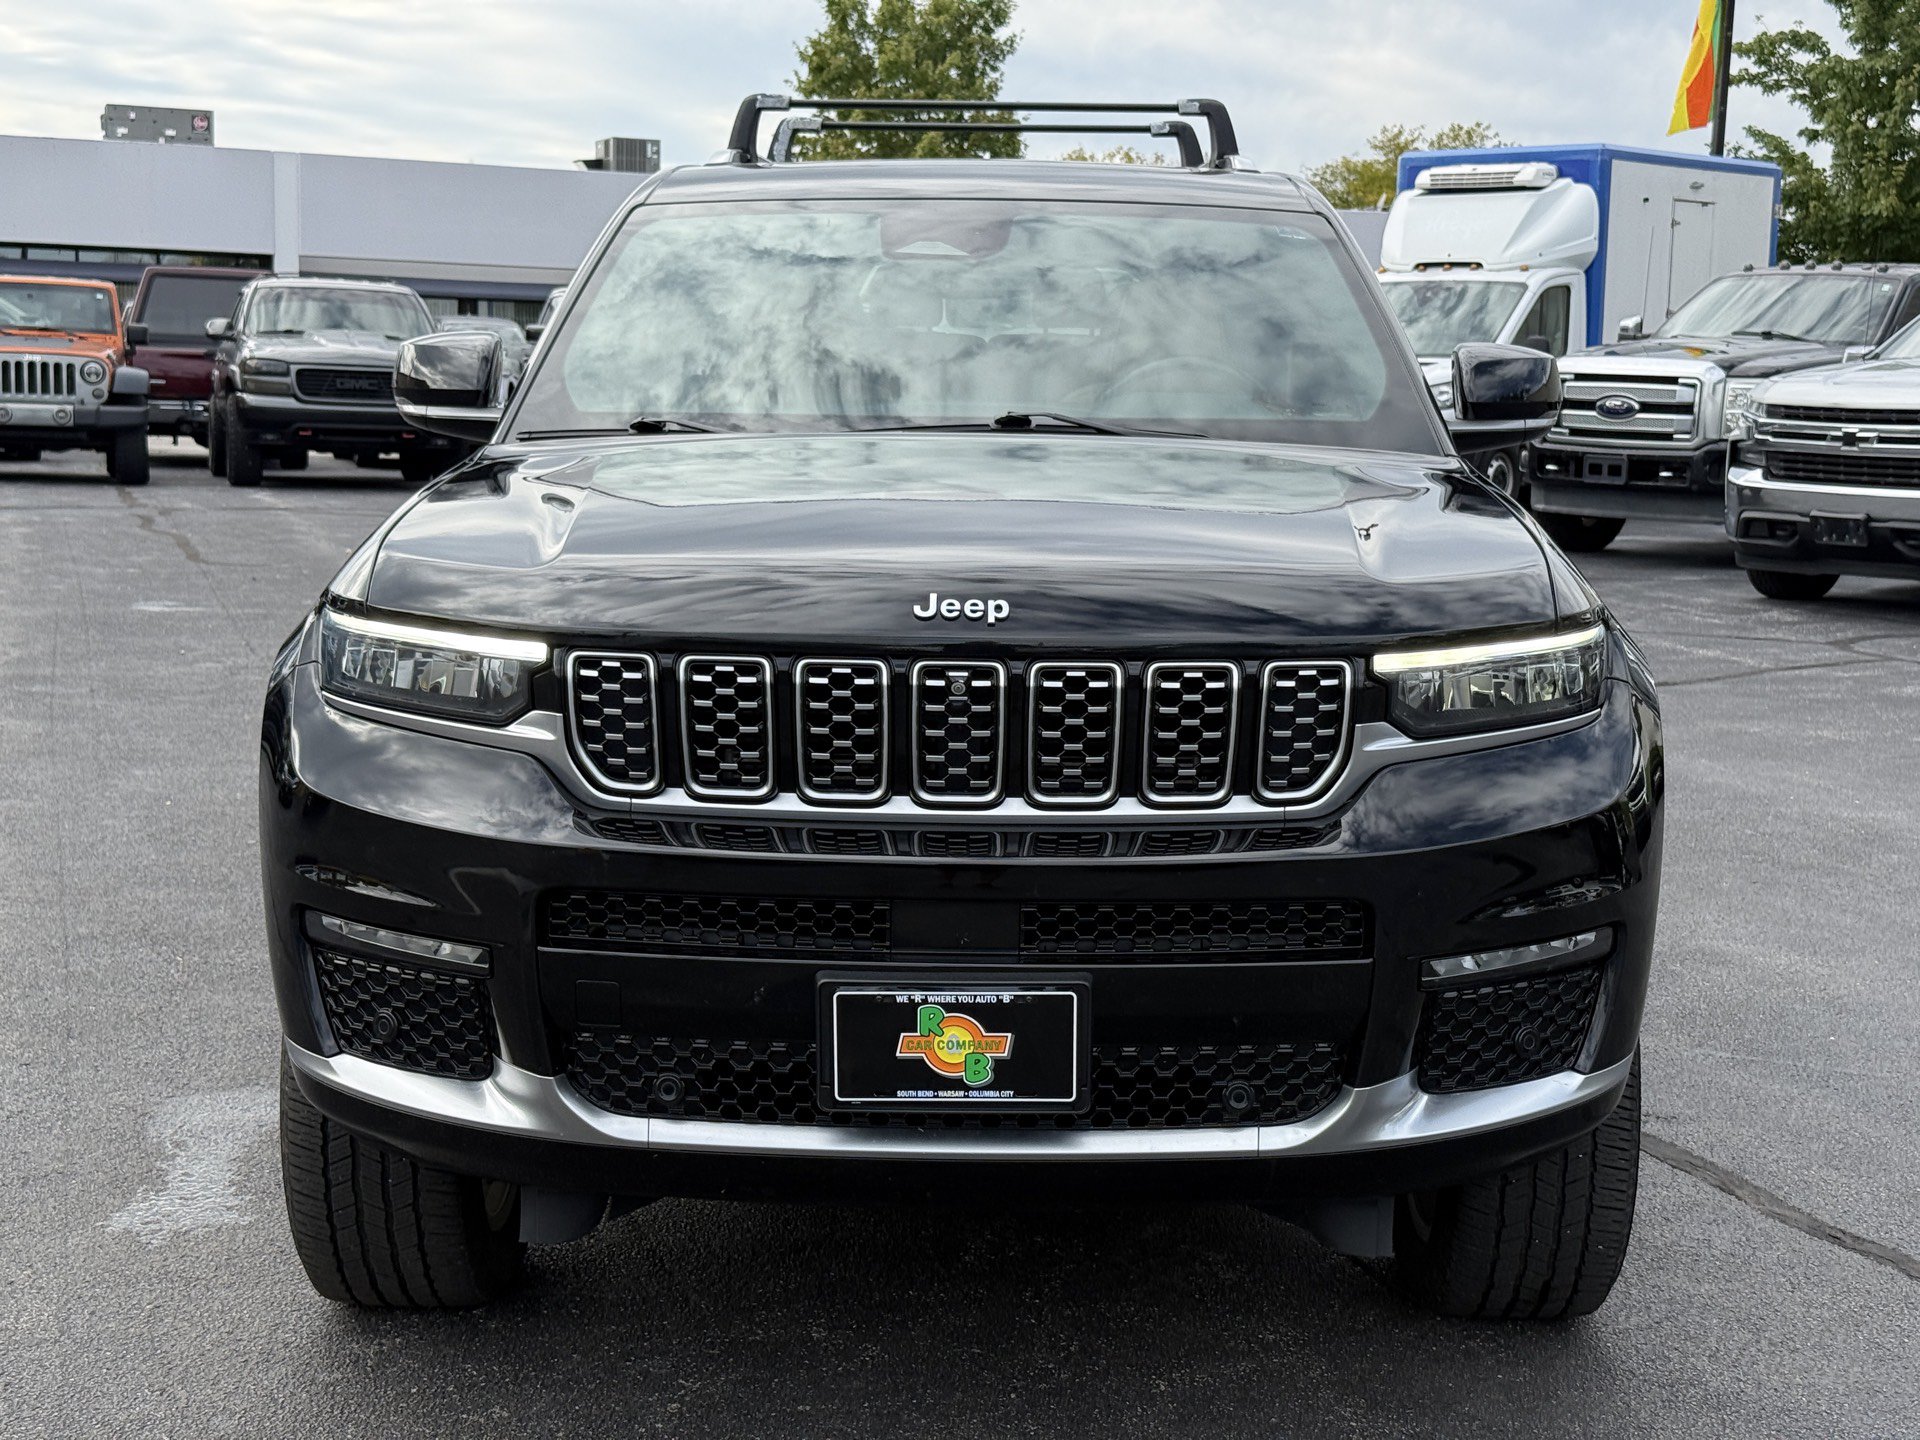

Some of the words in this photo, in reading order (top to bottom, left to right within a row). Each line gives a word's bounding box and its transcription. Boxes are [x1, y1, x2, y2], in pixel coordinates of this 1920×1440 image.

[336, 378, 379, 390] GMC
[912, 592, 1010, 626] Jeep
[895, 995, 909, 1003] WE
[911, 995, 925, 1003] "R"
[927, 995, 956, 1003] WHERE
[957, 995, 974, 1003] YOU
[975, 995, 996, 1003] AUTO
[999, 995, 1014, 1003] "B"
[919, 1005, 945, 1037] R
[906, 1039, 932, 1050] CAR
[937, 1039, 1002, 1050] COMPANY
[964, 1052, 990, 1084] B
